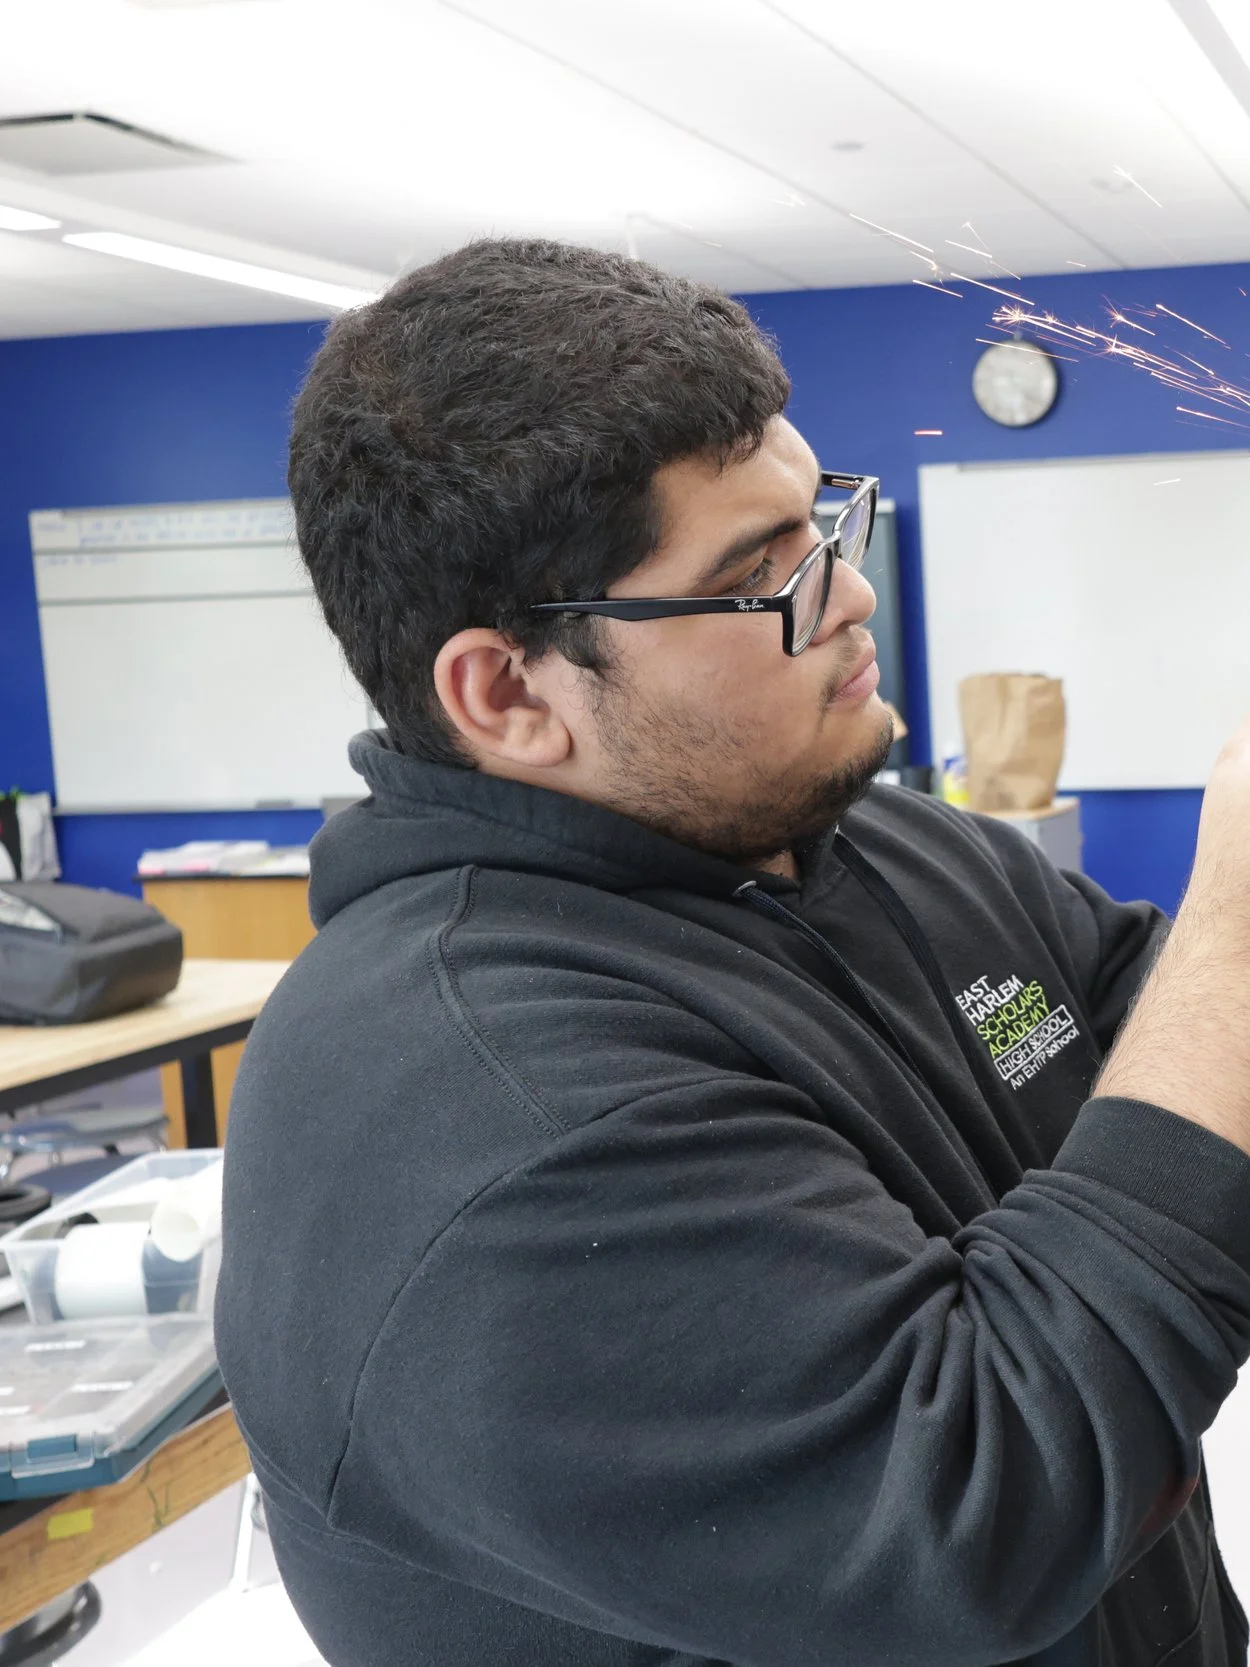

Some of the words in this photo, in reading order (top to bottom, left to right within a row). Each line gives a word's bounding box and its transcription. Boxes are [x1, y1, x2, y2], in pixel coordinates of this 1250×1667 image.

[954, 975, 991, 1011] EAST
[964, 974, 1024, 1026] HARLEM
[977, 980, 1043, 1040] SCHOLARS
[988, 994, 1050, 1059] ACADEMY
[999, 1044, 1032, 1075] HIGH
[1028, 1014, 1068, 1050] SCHOOL
[1010, 1074, 1026, 1091] An
[1046, 1025, 1080, 1058] School
